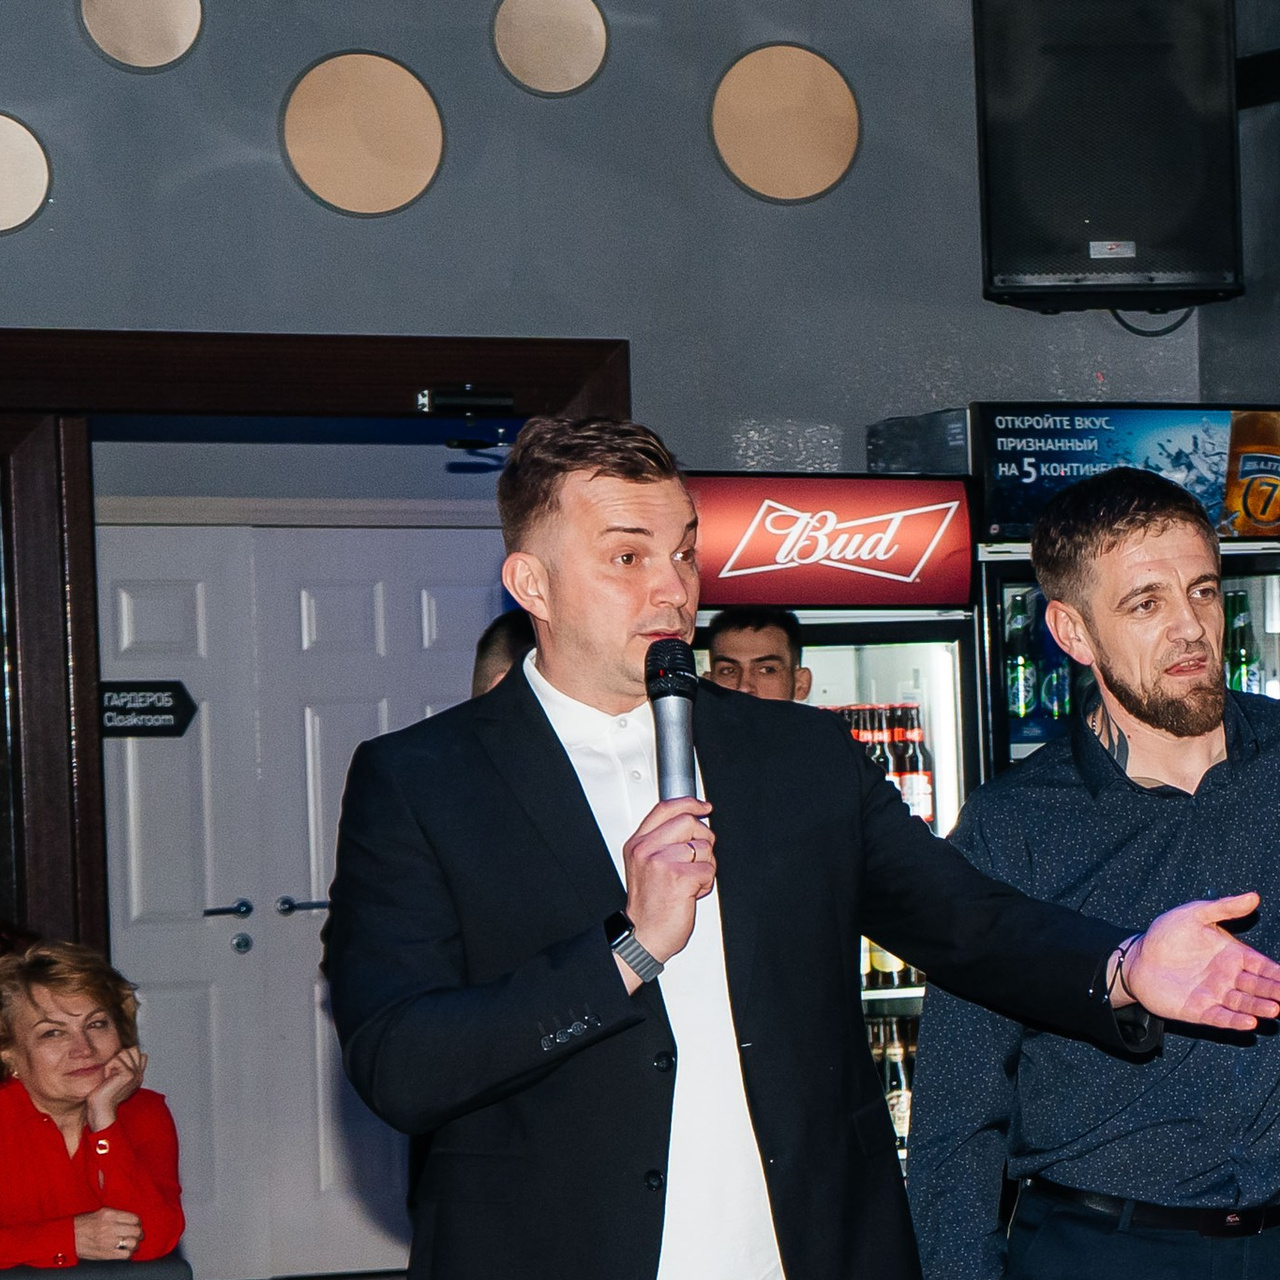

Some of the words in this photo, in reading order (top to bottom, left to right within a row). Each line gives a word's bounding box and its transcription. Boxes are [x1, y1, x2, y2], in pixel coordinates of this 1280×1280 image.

[995, 414, 1071, 429] ОТКРОЙТЕ
[997, 436, 1098, 451] ПРИЗНАННЫЙ
[998, 463, 1019, 476] НА
[1022, 457, 1037, 483] 5
[1259, 481, 1279, 516] 7
[764, 510, 899, 564] Bud
[104, 692, 173, 708] ГАРДЕРОБ
[104, 712, 174, 726] Cloakroom
